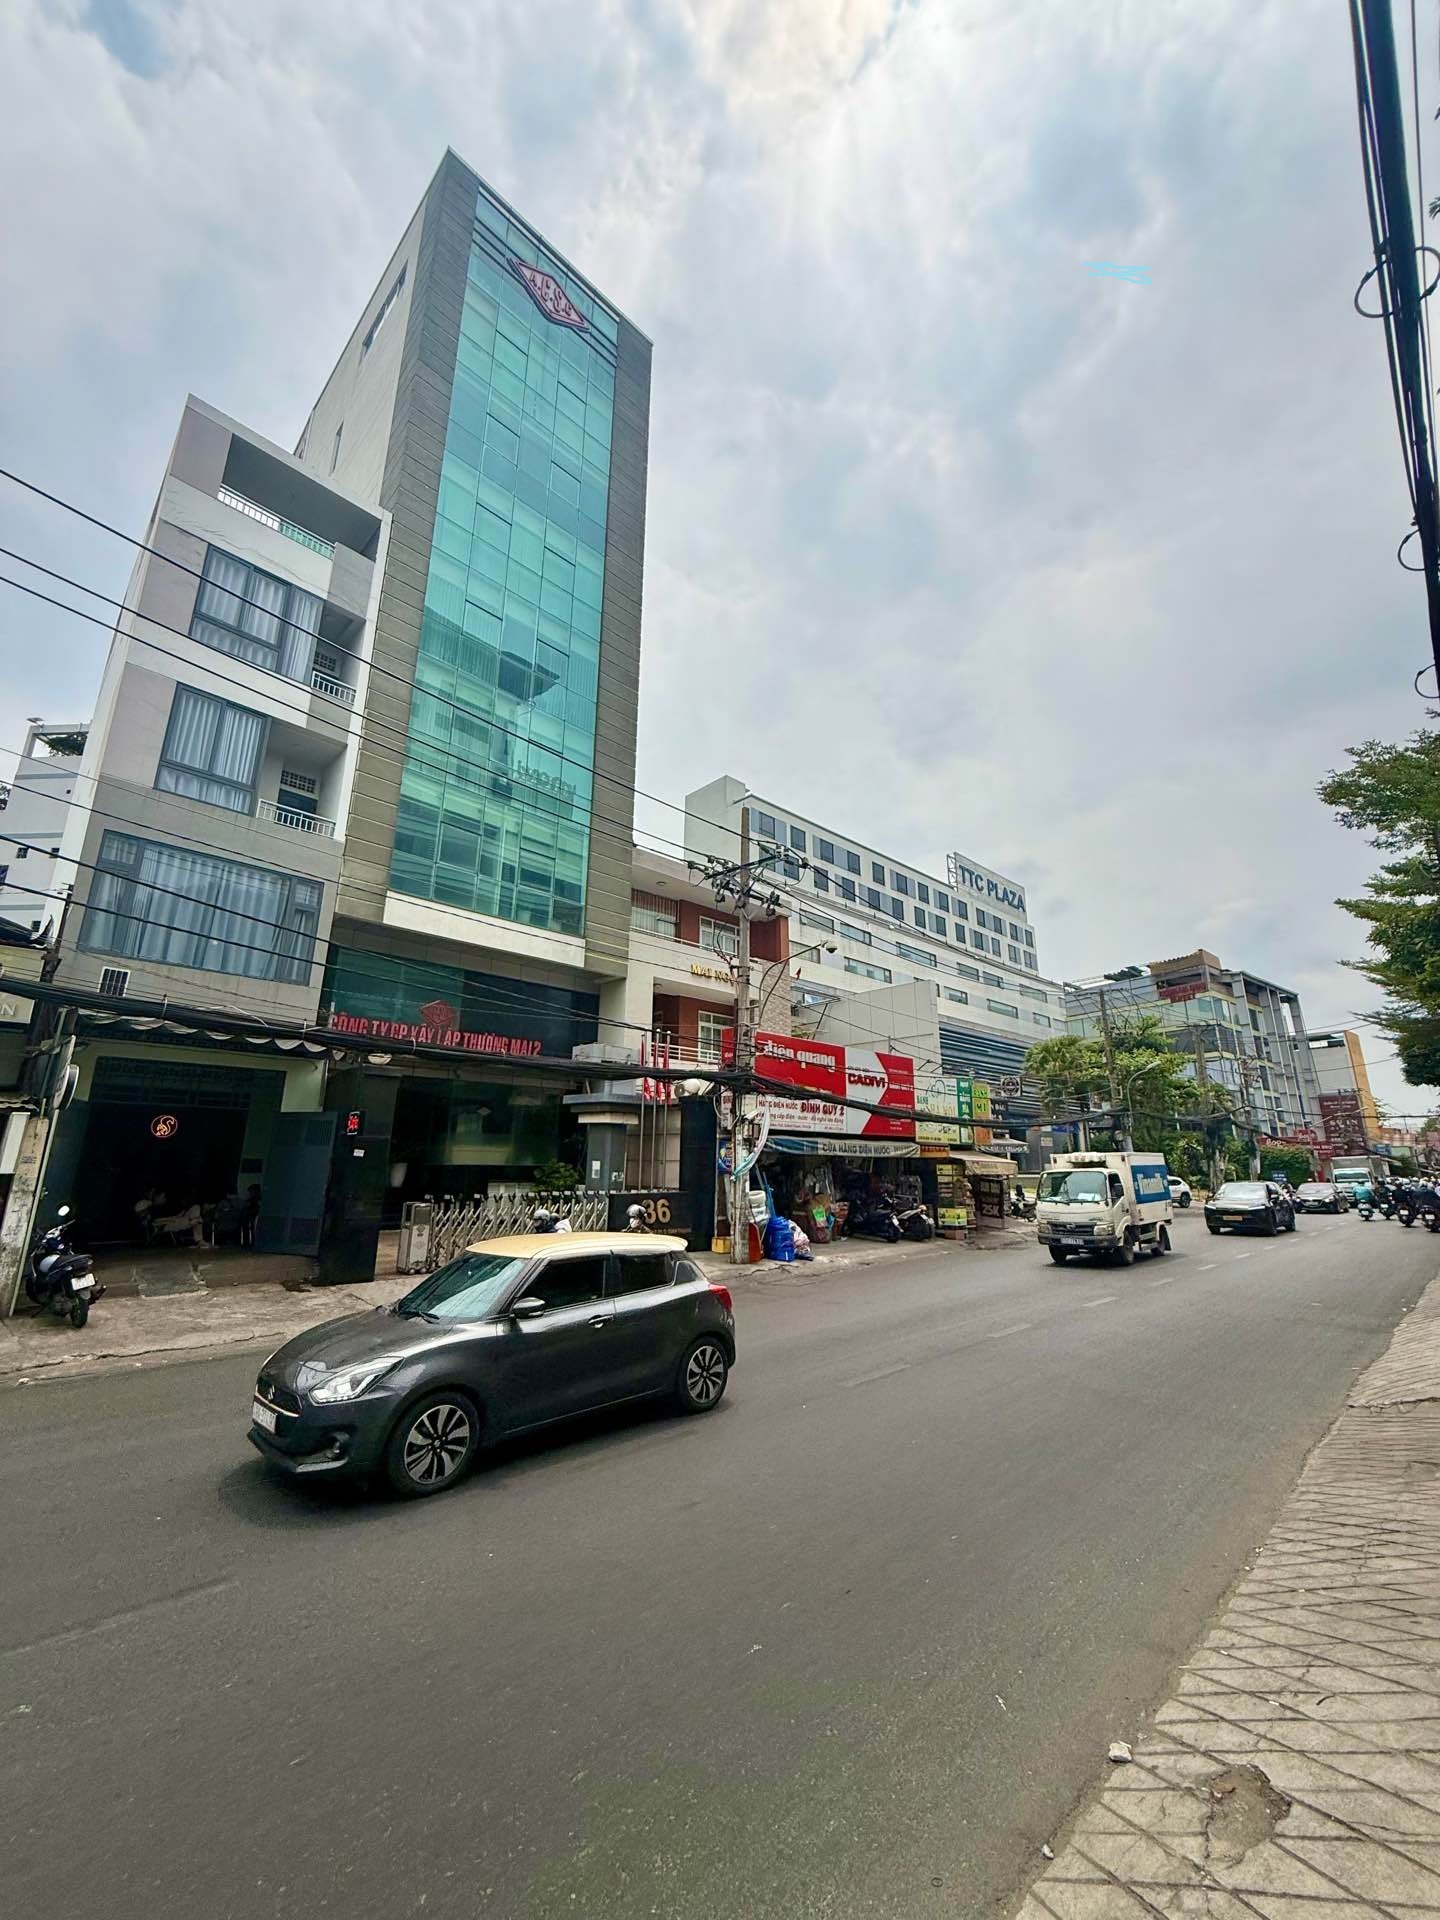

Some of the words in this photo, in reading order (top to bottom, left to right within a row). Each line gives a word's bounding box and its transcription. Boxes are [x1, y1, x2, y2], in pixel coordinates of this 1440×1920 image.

[959, 864, 984, 892] TTC
[986, 878, 1026, 913] PLAZA
[0, 1003, 17, 1016] N
[329, 1012, 368, 1035] CÔNG
[371, 1020, 388, 1037] TY
[390, 1022, 408, 1039] CP
[533, 1040, 542, 1057] 2
[797, 1050, 837, 1073] quang
[848, 1073, 886, 1088] CADIVI
[839, 1105, 845, 1116] 2
[642, 1198, 671, 1224] 36
